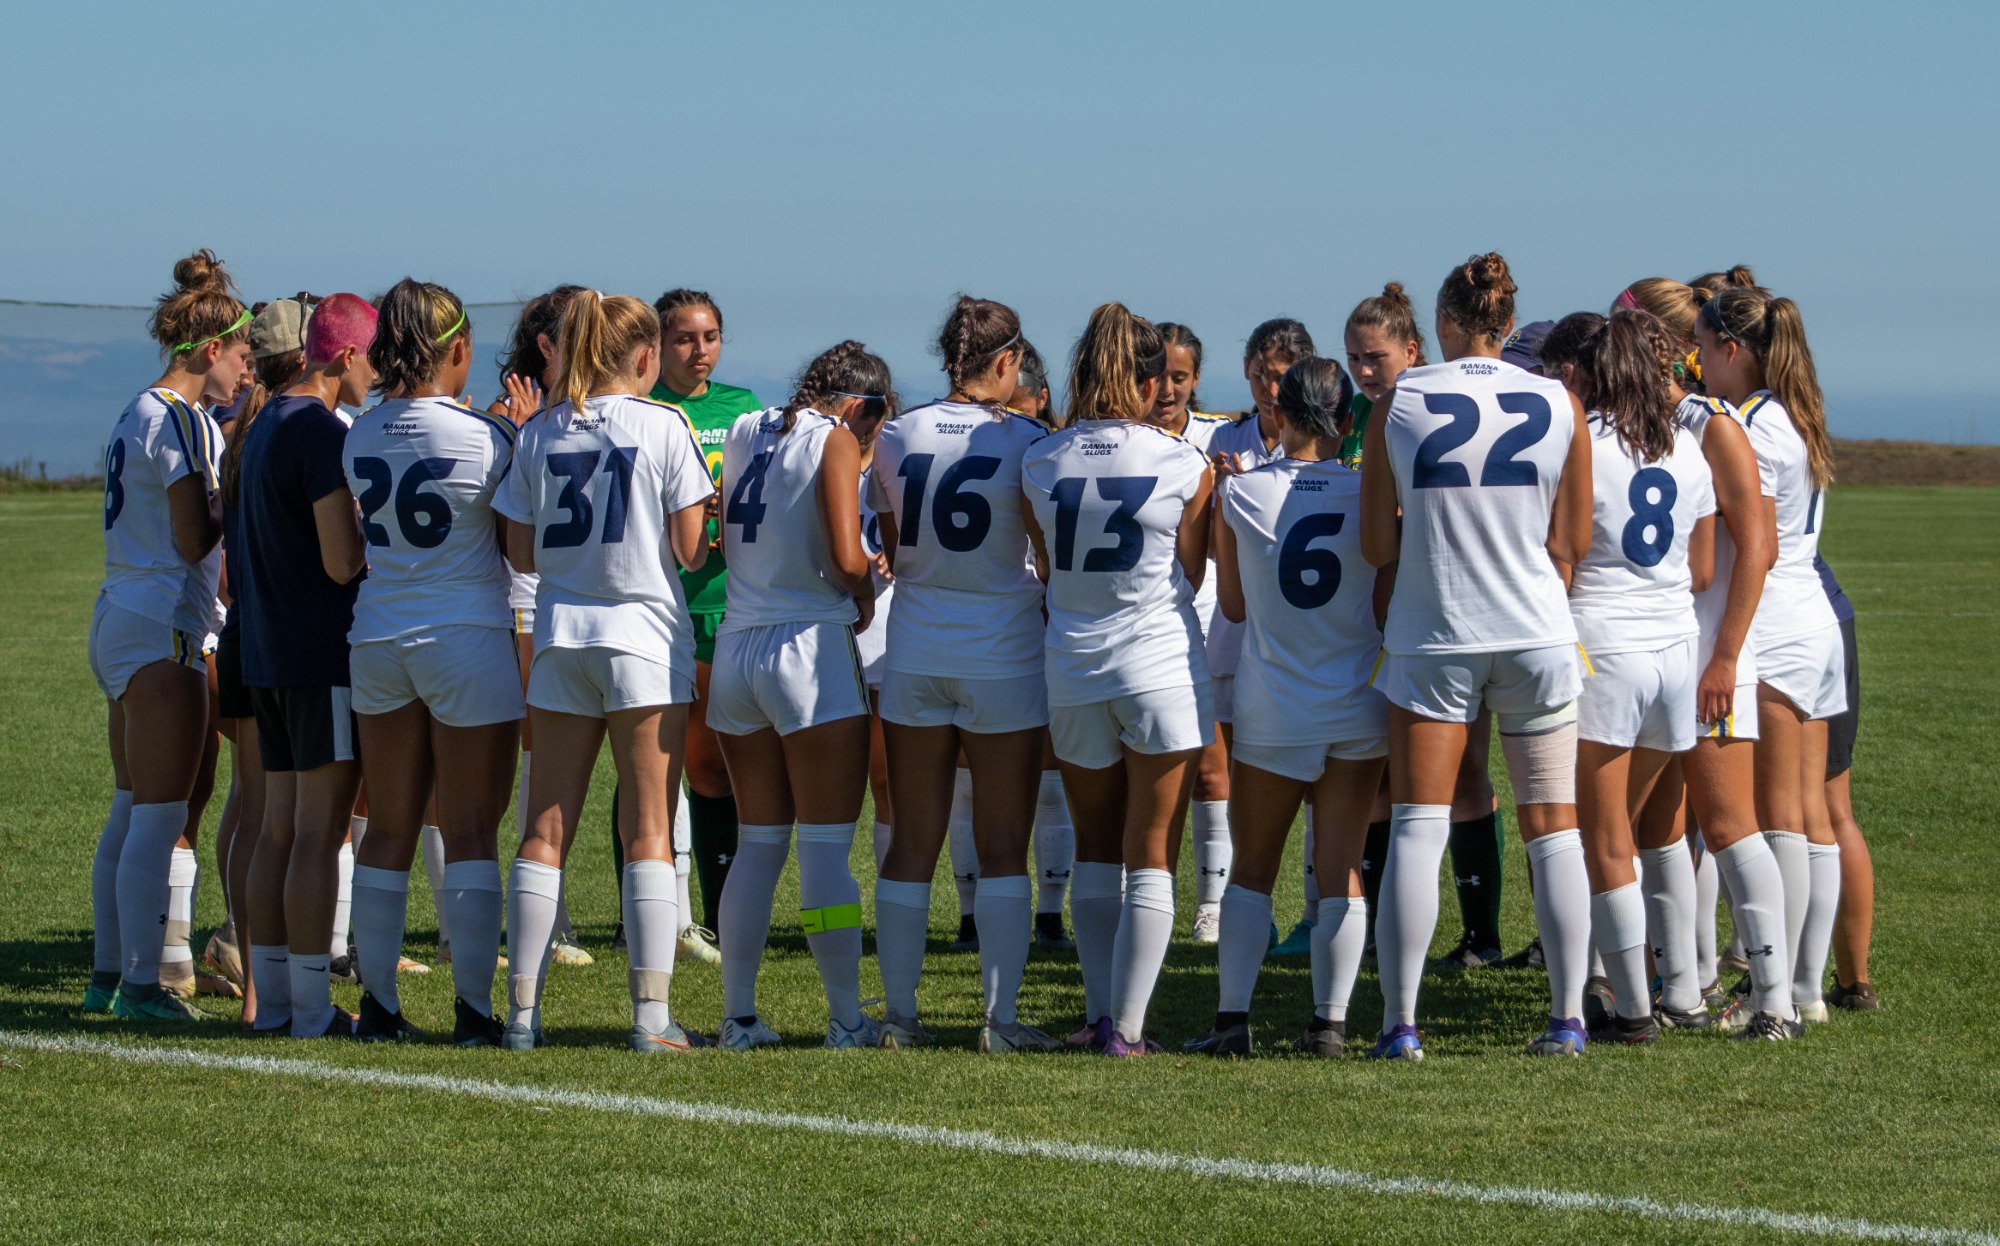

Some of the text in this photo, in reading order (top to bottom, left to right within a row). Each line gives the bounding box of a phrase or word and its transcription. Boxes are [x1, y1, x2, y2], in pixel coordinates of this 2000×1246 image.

[1460, 363, 1499, 371] BANANA
[382, 422, 417, 430] BANANA
[571, 417, 606, 426] BANANA
[575, 424, 600, 432] SLUGS
[935, 422, 974, 430] BANANA
[1080, 442, 1119, 450] BANANA
[1412, 391, 1552, 489] 22
[353, 456, 459, 549] 26
[542, 446, 639, 549] 31
[726, 451, 775, 544] 4
[897, 452, 1003, 553] 16
[1048, 476, 1159, 573] 13
[1621, 467, 1678, 568] 8
[1278, 512, 1346, 610] 6
